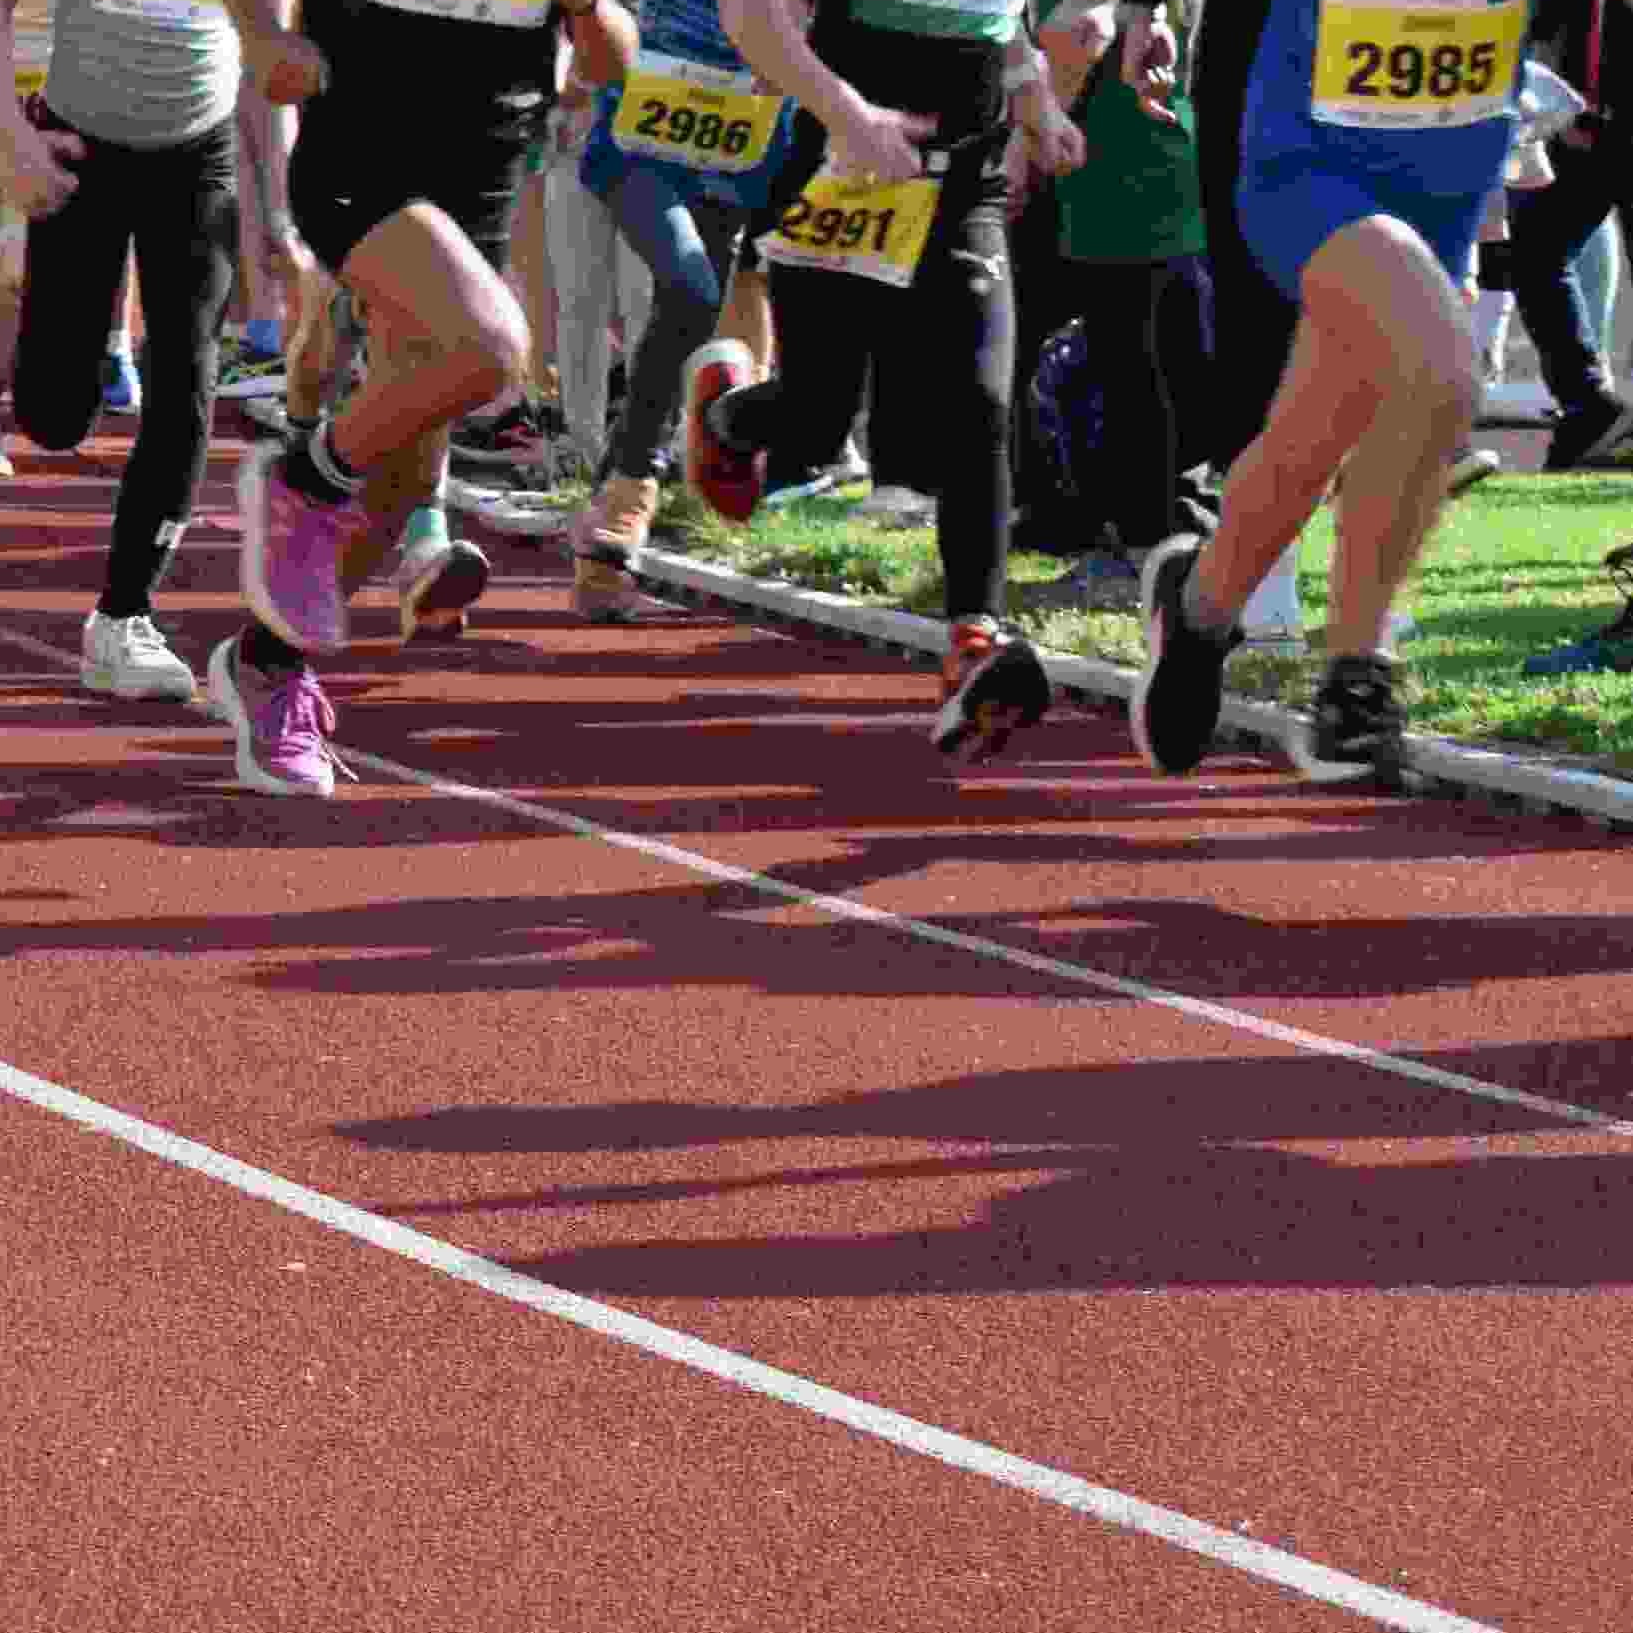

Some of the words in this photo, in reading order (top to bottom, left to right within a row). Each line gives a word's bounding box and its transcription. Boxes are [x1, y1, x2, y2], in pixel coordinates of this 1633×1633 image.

[1344, 41, 1495, 98] 2985
[636, 99, 753, 156] 2986
[782, 194, 896, 254] 2991
